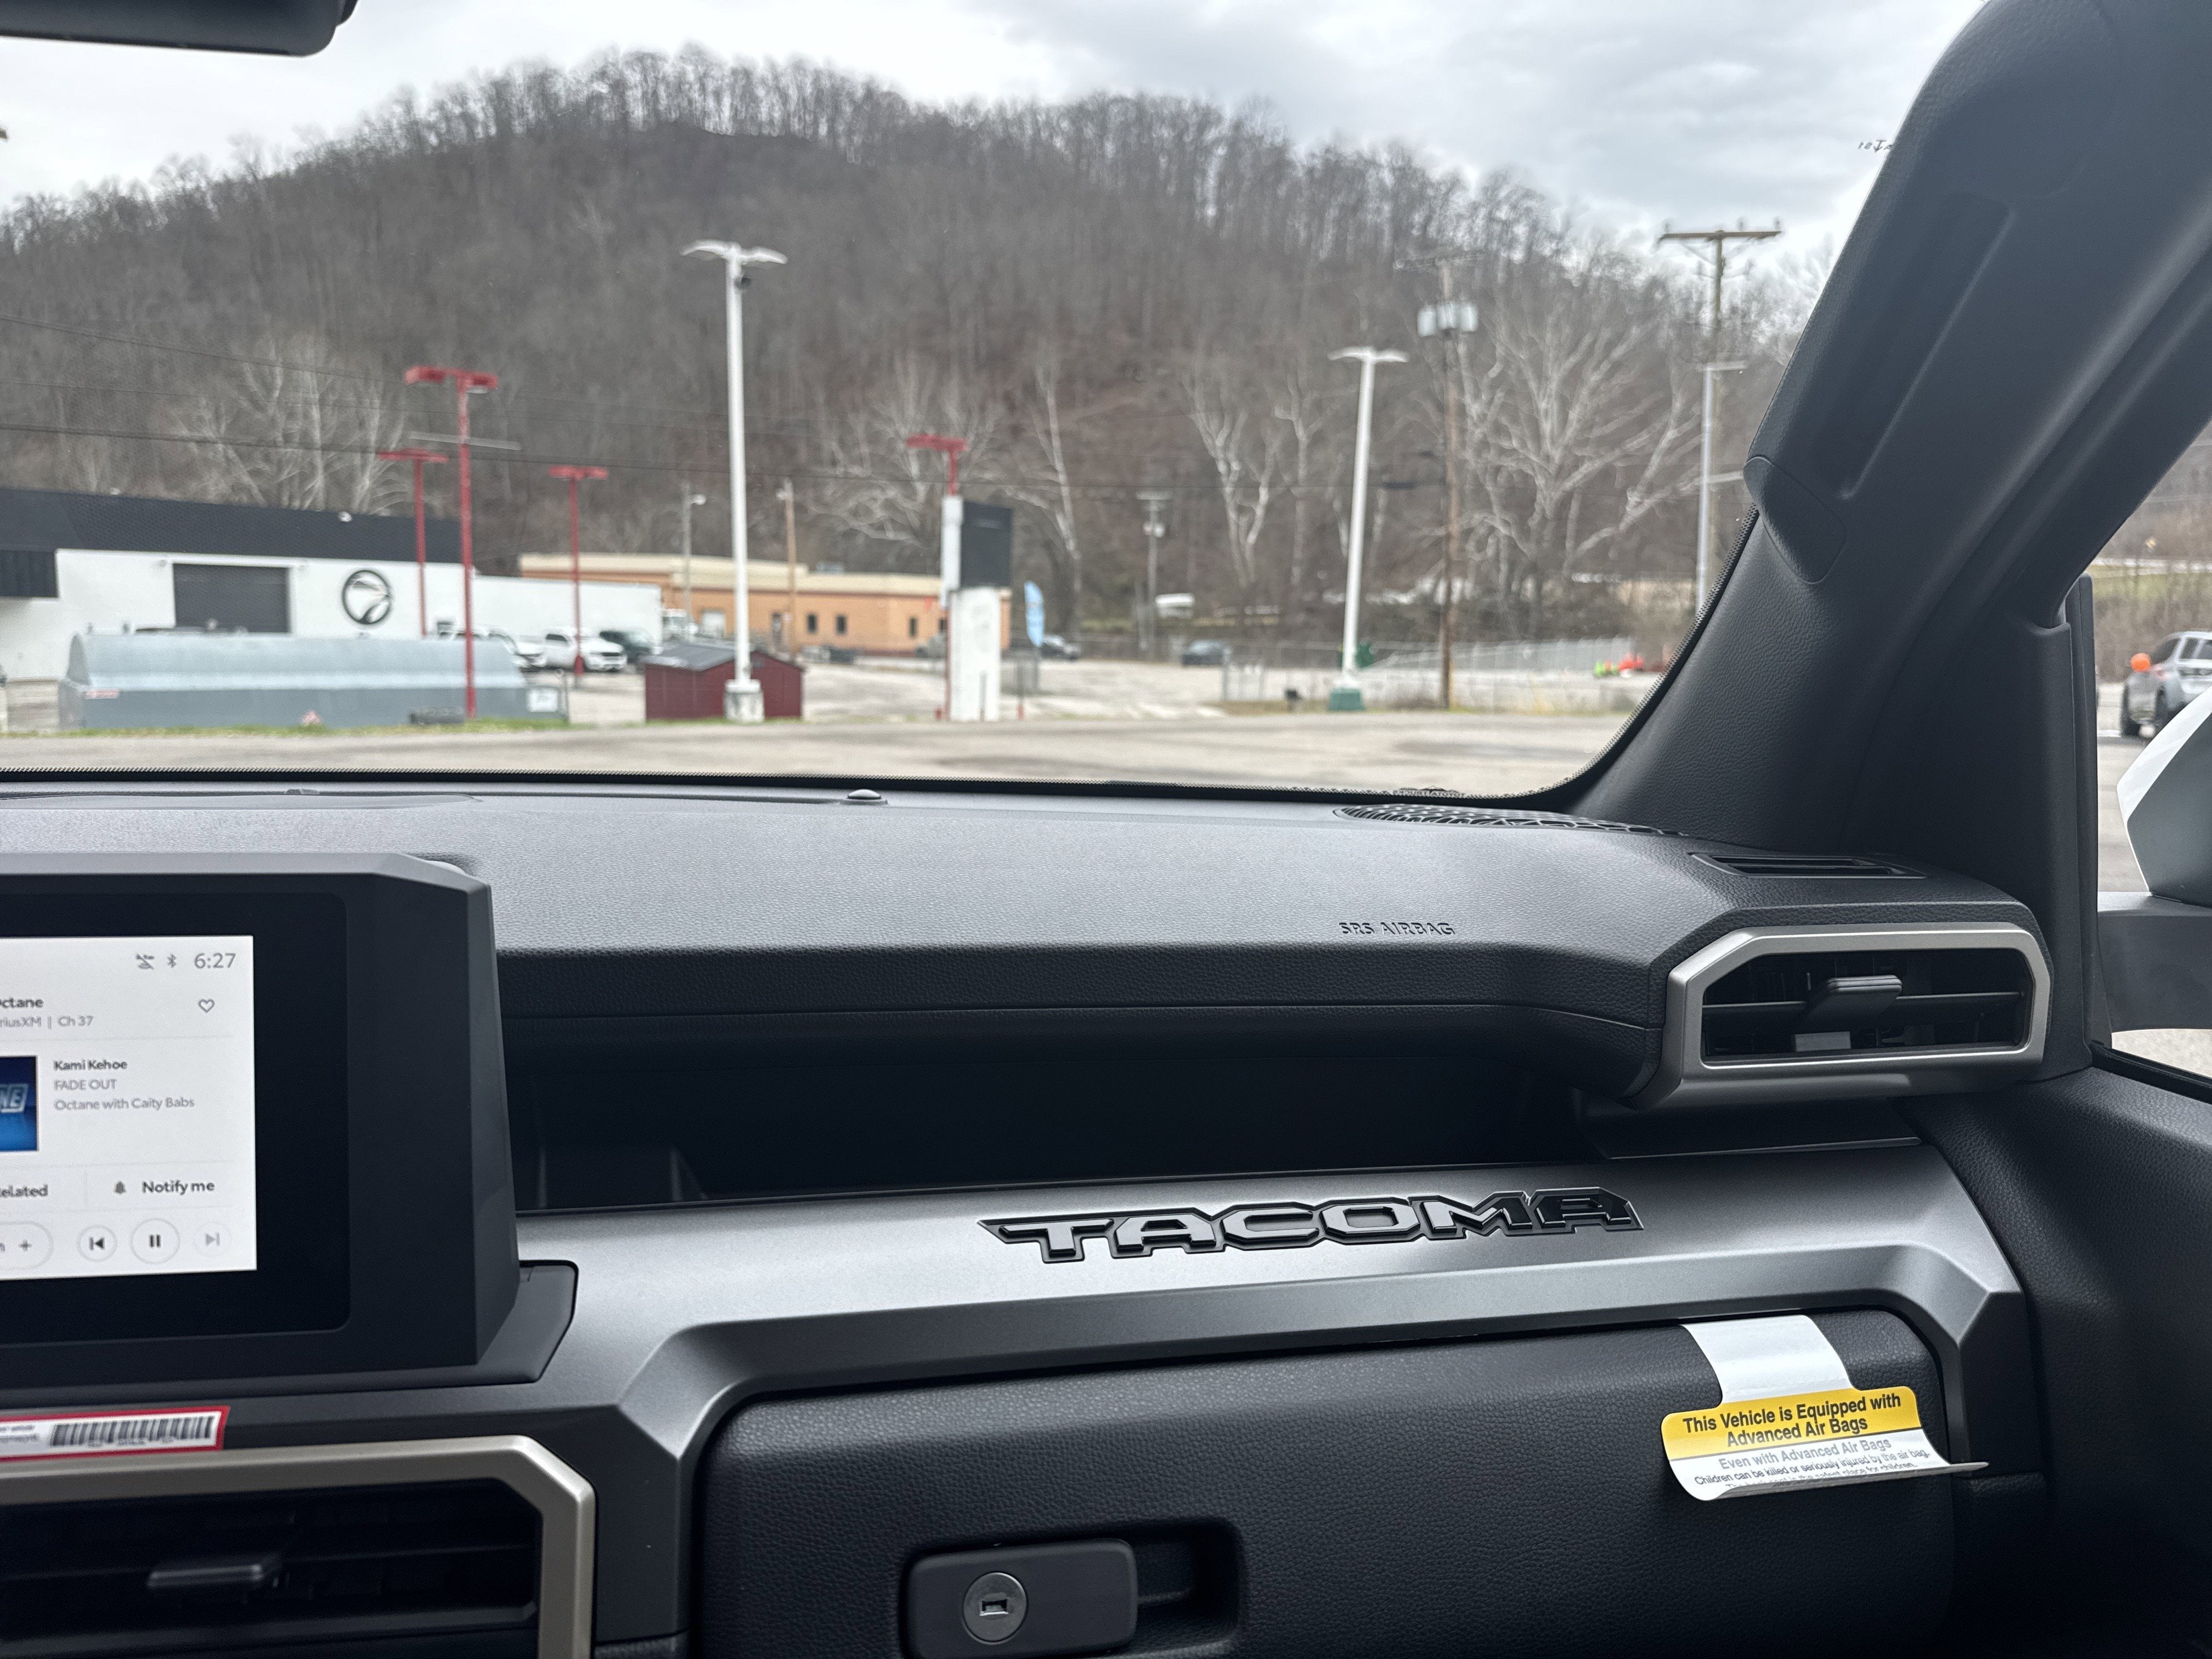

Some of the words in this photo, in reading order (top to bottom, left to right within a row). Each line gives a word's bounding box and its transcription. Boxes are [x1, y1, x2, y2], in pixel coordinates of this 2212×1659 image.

[1339, 922, 1374, 934] SRS
[1380, 922, 1455, 935] AIRBAG
[194, 952, 236, 969] 6:27
[57, 1016, 76, 1027] Ch
[78, 1015, 93, 1026] 37
[53, 1059, 85, 1070] Kami
[87, 1059, 128, 1070] Kehoe
[53, 1079, 86, 1091] FADE
[88, 1079, 117, 1090] OUT
[54, 1099, 100, 1110] Octane
[102, 1098, 129, 1109] with
[131, 1097, 163, 1111] Caity
[165, 1097, 195, 1108] Babs
[0, 1184, 48, 1198] elated
[142, 1180, 189, 1195] Notify
[191, 1182, 215, 1192] me
[988, 1190, 1638, 1261] TACOMA
[1682, 1415, 1717, 1433] This
[1720, 1408, 1775, 1429] Vehicle
[1779, 1406, 1793, 1421] is
[1796, 1396, 1867, 1421] Equipped
[1870, 1393, 1901, 1410] with
[1728, 1423, 1802, 1447] Advanced
[1805, 1420, 1825, 1437] Air
[1829, 1418, 1868, 1435] Bags
[1718, 1457, 1751, 1470] Even
[1752, 1452, 1779, 1466] with
[1781, 1443, 1840, 1462] Advanced
[1842, 1441, 1858, 1454] Air
[1859, 1438, 1892, 1452] Bags
[1694, 1472, 1734, 1485] Children
[1734, 1472, 1752, 1480] can
[1750, 1470, 1765, 1478] be
[1765, 1466, 1789, 1476] killed
[1800, 1459, 1838, 1471] seriously
[1838, 1455, 1870, 1468] injured
[1870, 1453, 1882, 1464] by
[1881, 1452, 1897, 1461] the
[1898, 1449, 1910, 1459] air
[1908, 1448, 1930, 1459] bag.
